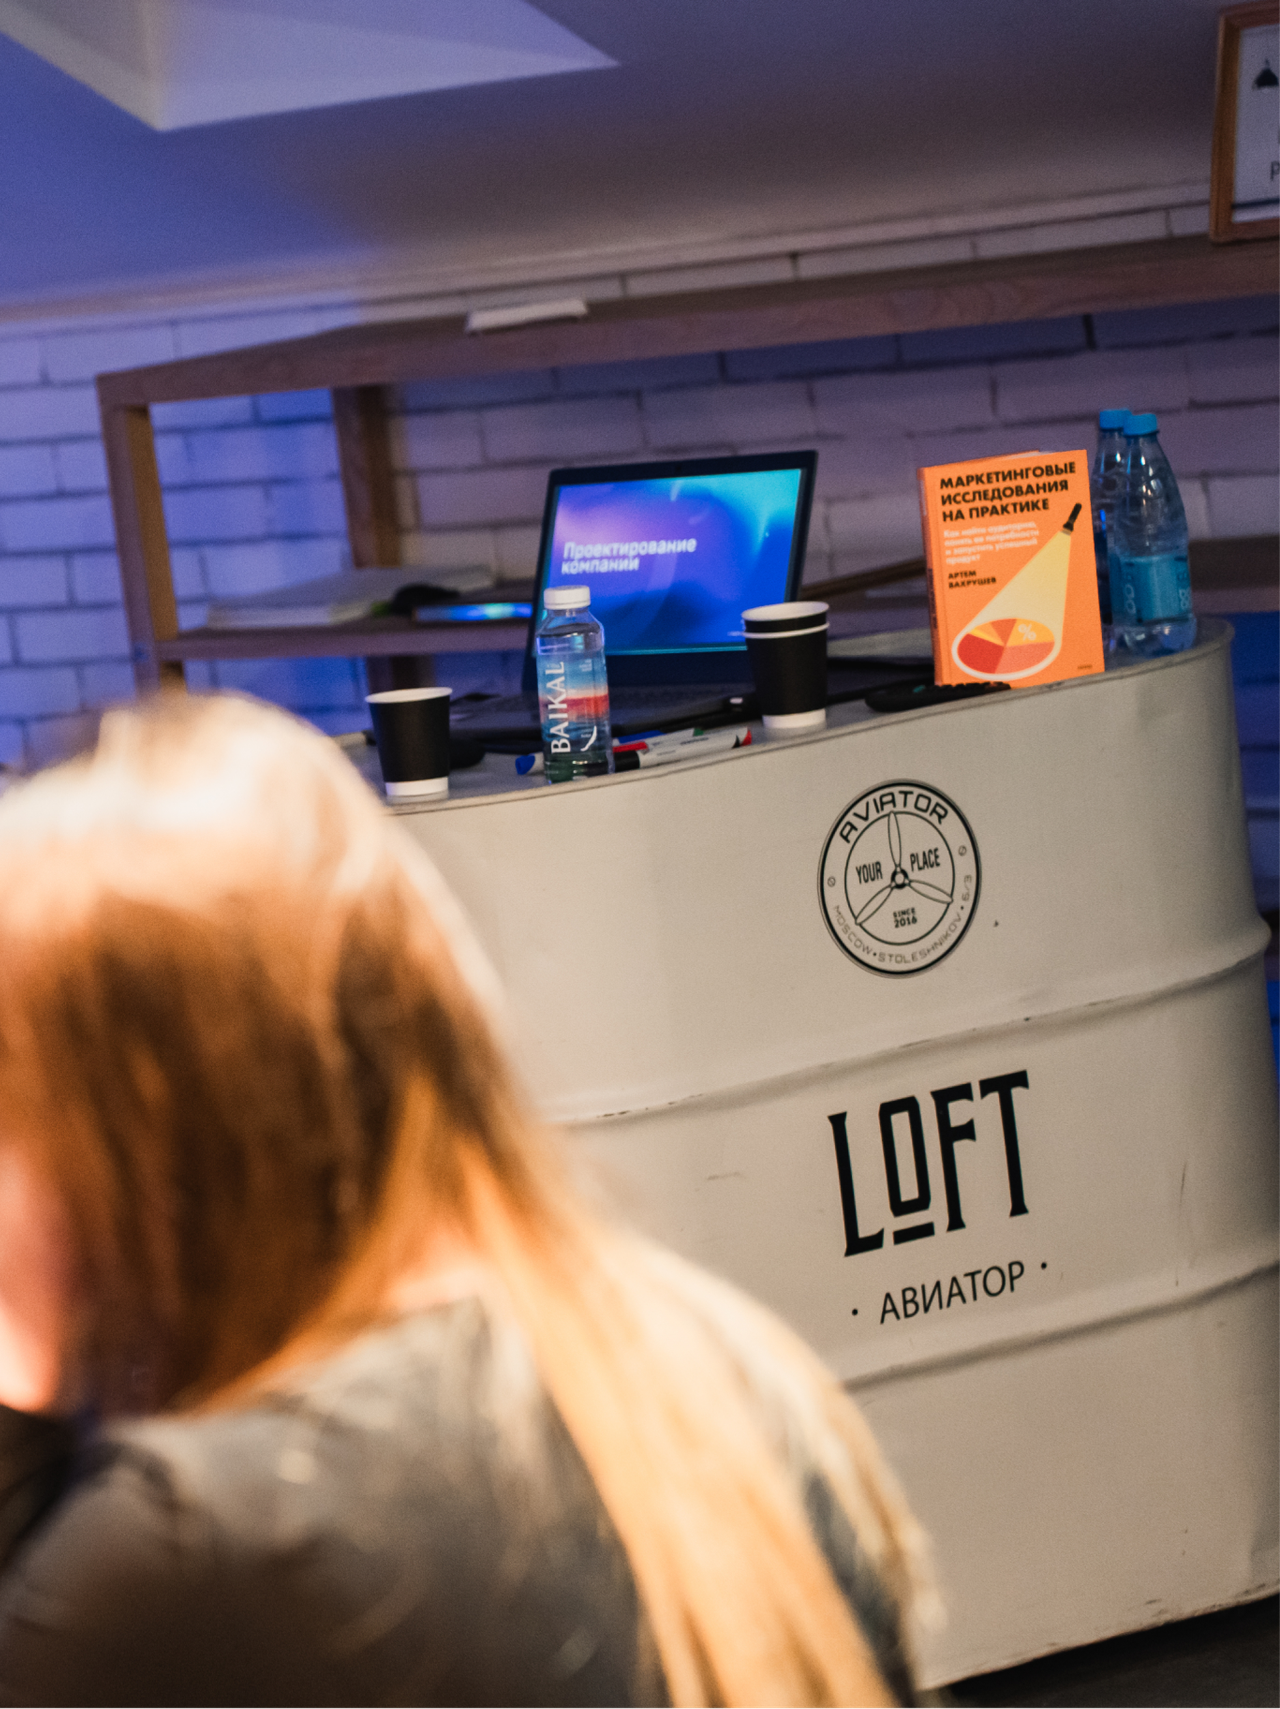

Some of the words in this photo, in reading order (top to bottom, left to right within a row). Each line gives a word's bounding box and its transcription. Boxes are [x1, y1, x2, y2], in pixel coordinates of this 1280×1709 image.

[940, 461, 1076, 489] МАРКЕТИНГОВЫЕ
[941, 479, 1069, 506] ИССЛЕДОВАНИЯ
[942, 509, 965, 522] НА
[969, 498, 1050, 520] ПРАКТИКЕ
[563, 538, 697, 559] Проектирование
[948, 577, 997, 588] ВАХРУШЕВ
[545, 661, 571, 754] BAIKAL
[839, 790, 949, 844] AVIATOR
[855, 861, 883, 884] YOUR
[910, 847, 941, 872] PLACE
[893, 907, 916, 919] SINCE
[893, 916, 918, 928] 2016
[833, 904, 873, 955] MOSCOW
[877, 912, 962, 964] STOLESHNIKOV
[827, 1069, 1029, 1258] LOFT
[880, 1260, 1025, 1325] АВИАТОР
